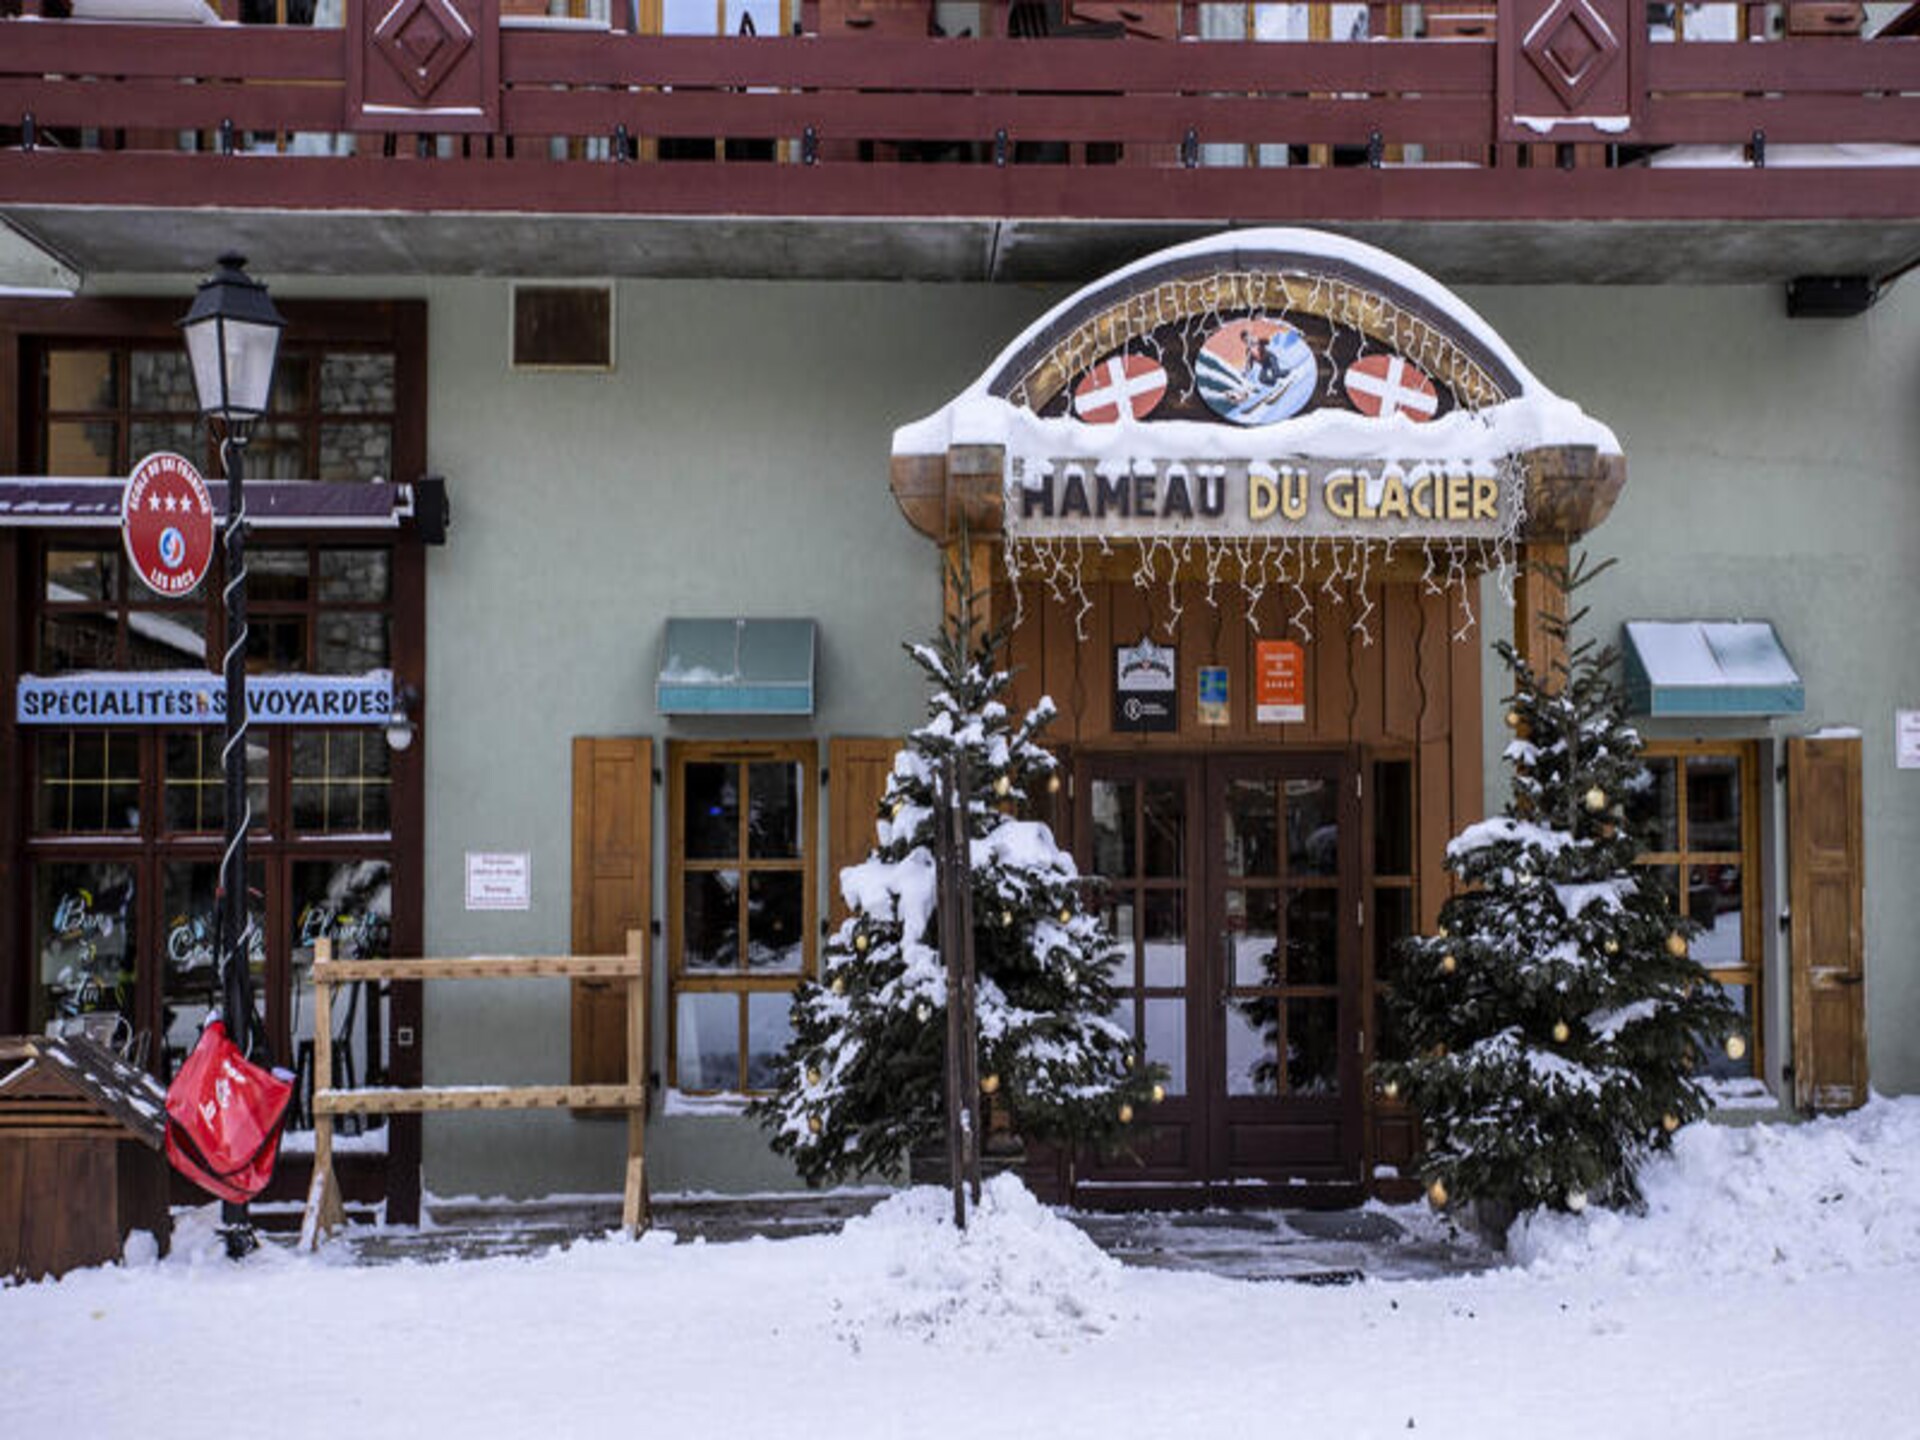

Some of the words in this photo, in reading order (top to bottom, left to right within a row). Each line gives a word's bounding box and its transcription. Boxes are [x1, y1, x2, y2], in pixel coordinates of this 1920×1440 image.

[1022, 470, 1226, 519] HAMEAU
[1248, 471, 1307, 520] DU
[1325, 471, 1499, 520] GLACIER
[212, 689, 391, 716] SVOYARDES
